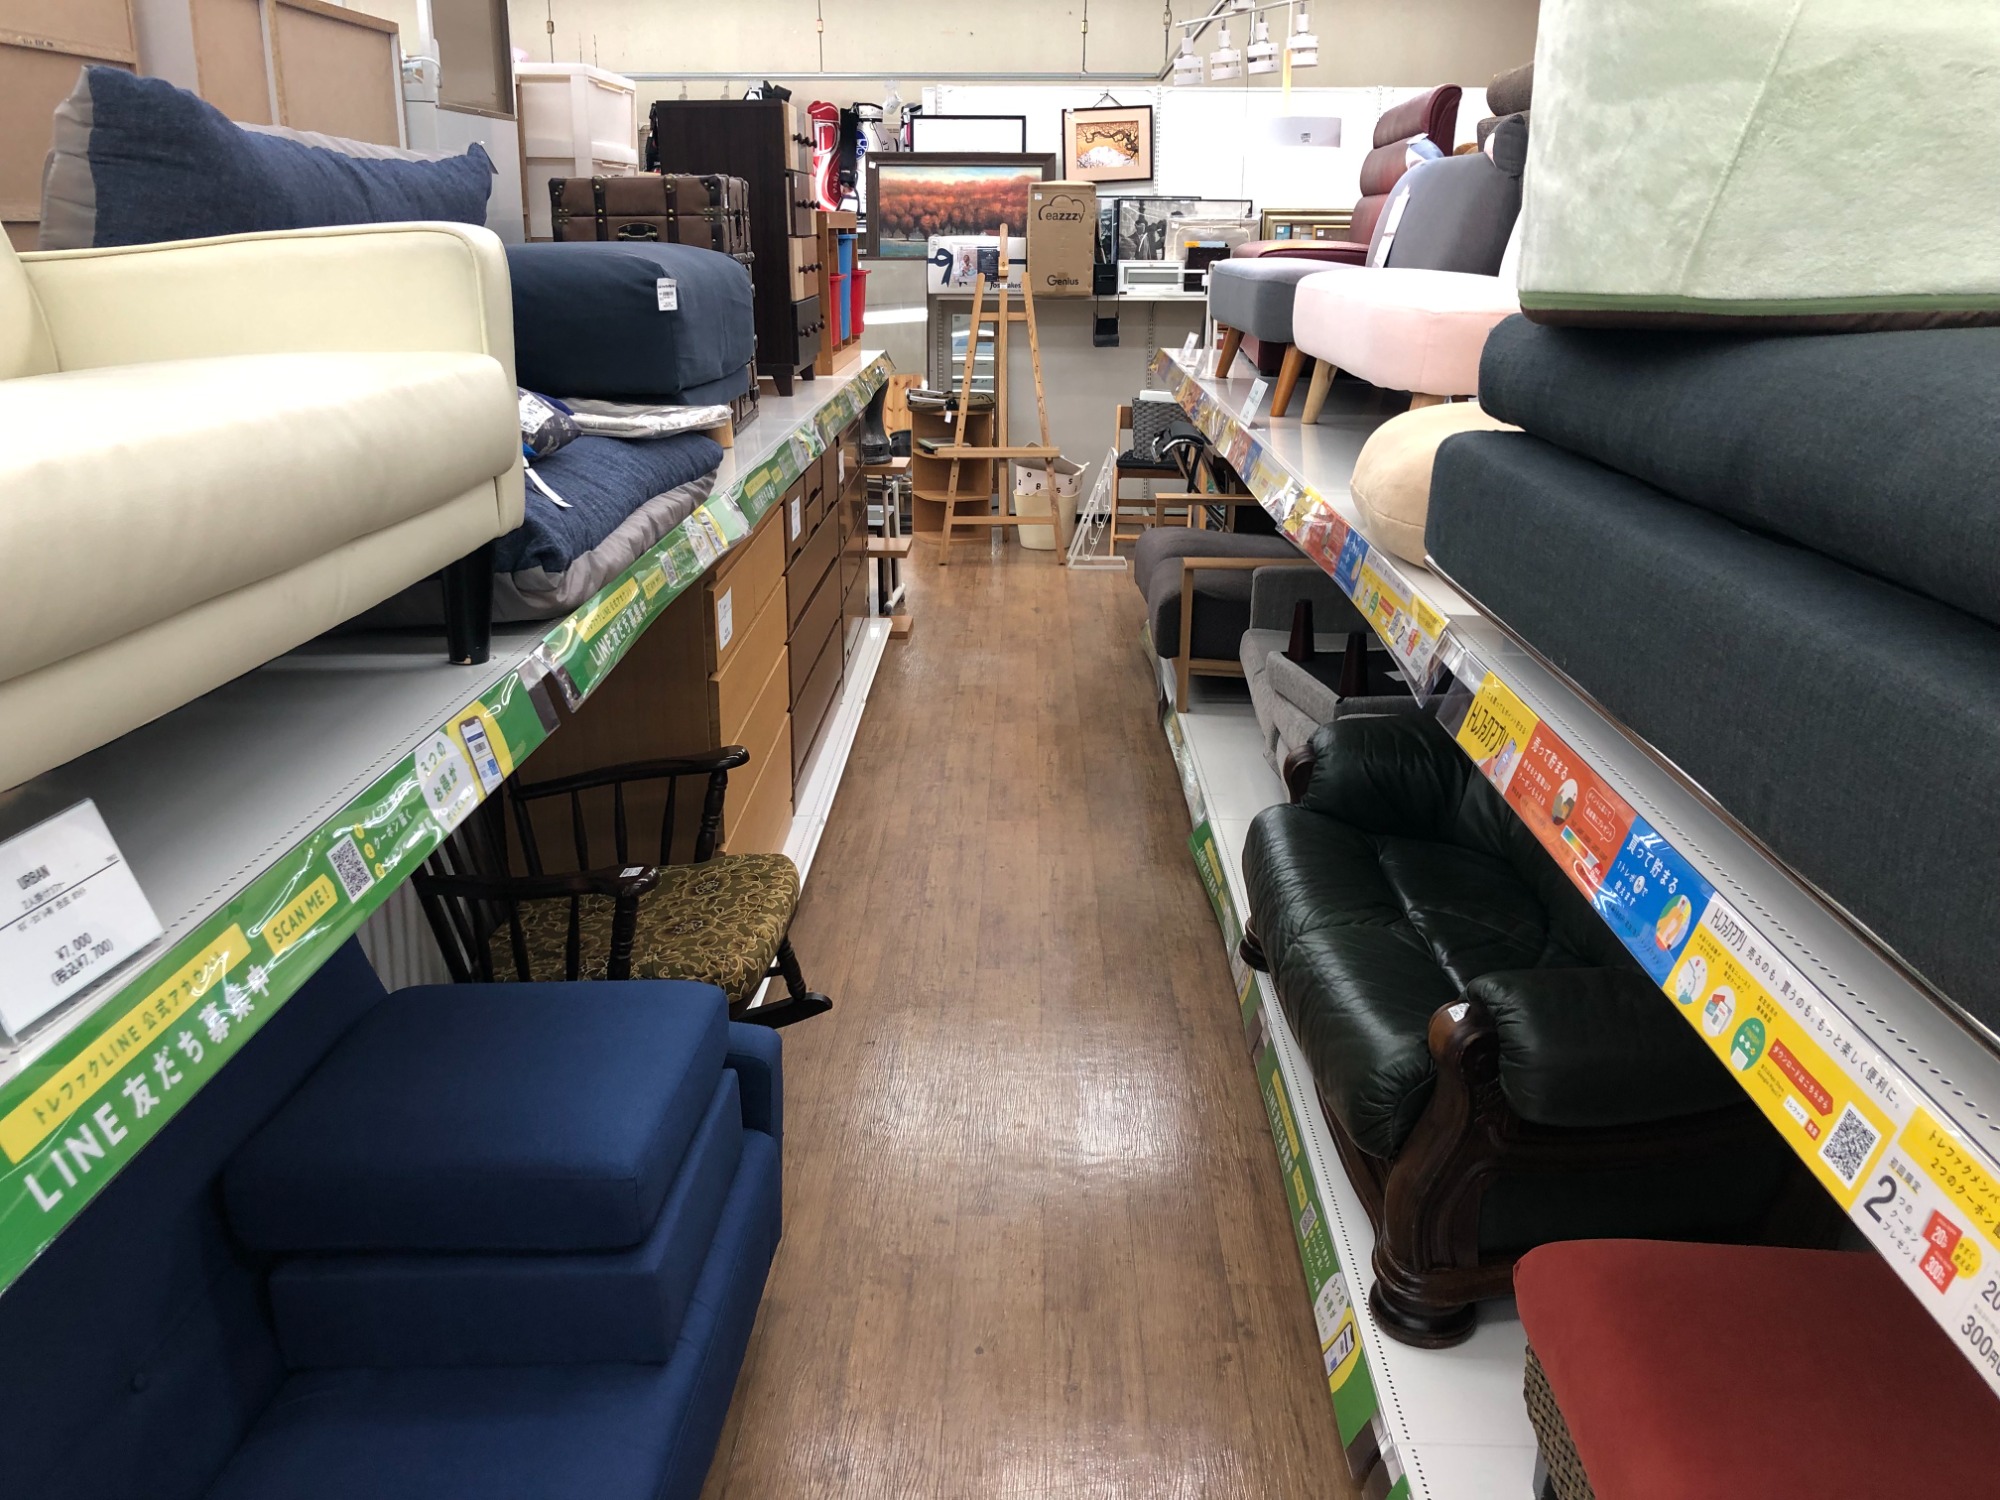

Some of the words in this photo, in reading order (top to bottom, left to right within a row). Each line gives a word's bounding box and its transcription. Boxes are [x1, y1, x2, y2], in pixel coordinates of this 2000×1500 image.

[1045, 211, 1085, 223] eazzzy
[1046, 274, 1080, 286] Genius
[1531, 736, 1569, 780] 売って貯まる
[16, 864, 51, 890] URBAN
[1626, 834, 1679, 894] 買って貯まる
[273, 906, 307, 944] SCAN
[304, 884, 330, 915] ME!
[1772, 1045, 1829, 1110] ダウンロードはこちらから
[1863, 1175, 1897, 1223] 2
[1881, 1222, 1917, 1264] プレゼント
[1889, 1209, 1919, 1242] クーポン
